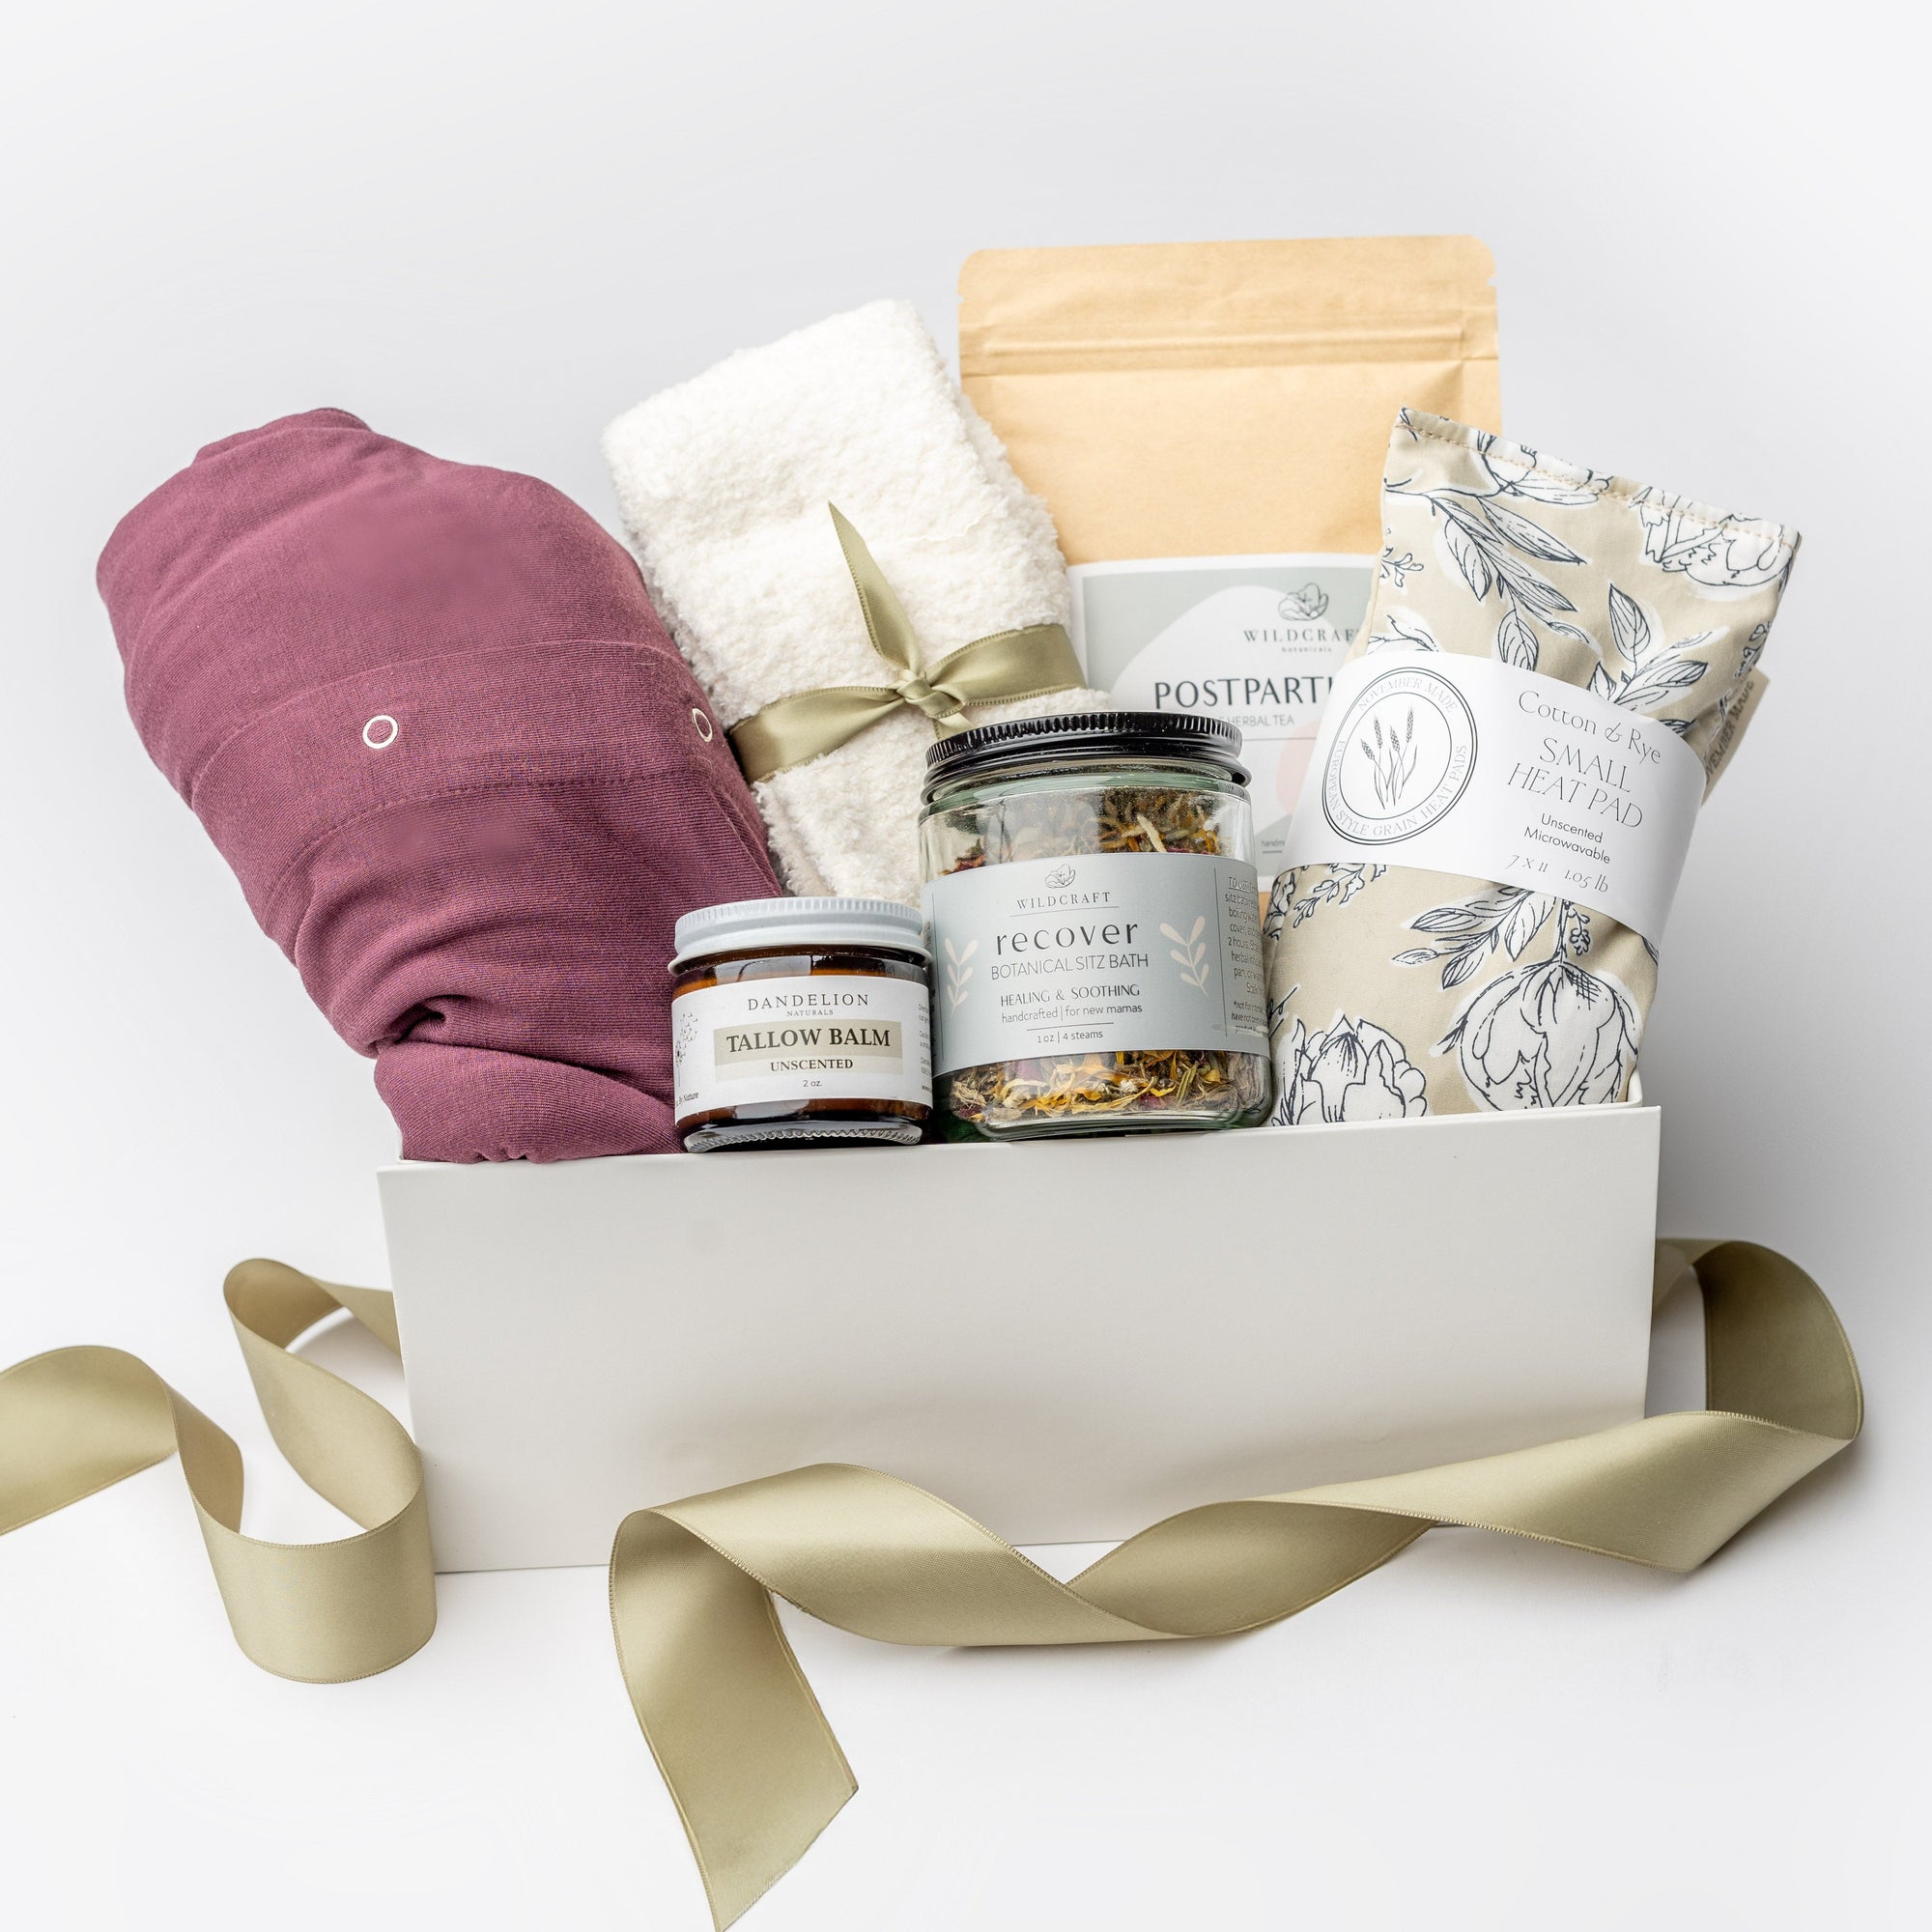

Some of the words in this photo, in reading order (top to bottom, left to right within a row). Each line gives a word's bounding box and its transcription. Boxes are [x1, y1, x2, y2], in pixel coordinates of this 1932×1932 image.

[1243, 629, 1359, 642] WILDCRAF
[1358, 677, 1423, 711] NOVEMBER
[1425, 682, 1458, 713] MADE
[1273, 714, 1294, 725] TEA
[1519, 690, 1597, 735] Cotton
[1605, 723, 1622, 743] &
[1628, 728, 1661, 764] Rye
[1328, 740, 1346, 811] EUROPEAN
[1449, 745, 1467, 781] PADS
[1540, 737, 1631, 793] SMALL
[1420, 784, 1454, 819] HEAT
[1508, 762, 1586, 803] HEAT
[1587, 788, 1643, 828] PAD
[1336, 810, 1369, 836] STYLE
[1373, 815, 1419, 836] GRAIN
[1541, 812, 1604, 843] Unscented
[1523, 826, 1611, 865] Microwavable
[1506, 854, 1520, 869] 7
[1594, 874, 1608, 893] lb
[1016, 891, 1111, 909] WILDCRAFT
[996, 923, 1138, 955] recover
[991, 957, 1073, 980] BOTANICAL
[1075, 954, 1105, 971] SITZ
[1109, 952, 1149, 969] BATH
[748, 993, 869, 1010] DANDELION
[1000, 990, 1050, 1008] HEALING
[1055, 988, 1065, 1001] &
[1070, 983, 1141, 999] SOOTHING
[1001, 1007, 1059, 1024] handcrafted
[1065, 1006, 1081, 1016] for
[1082, 1006, 1104, 1016] new
[1106, 1004, 1143, 1014] mamas
[726, 1028, 821, 1053] TALLOW
[829, 1028, 891, 1047] BALM
[1063, 1032, 1068, 1040] 4
[1070, 1030, 1103, 1039] steams
[770, 1059, 854, 1072] UNSCENTED
